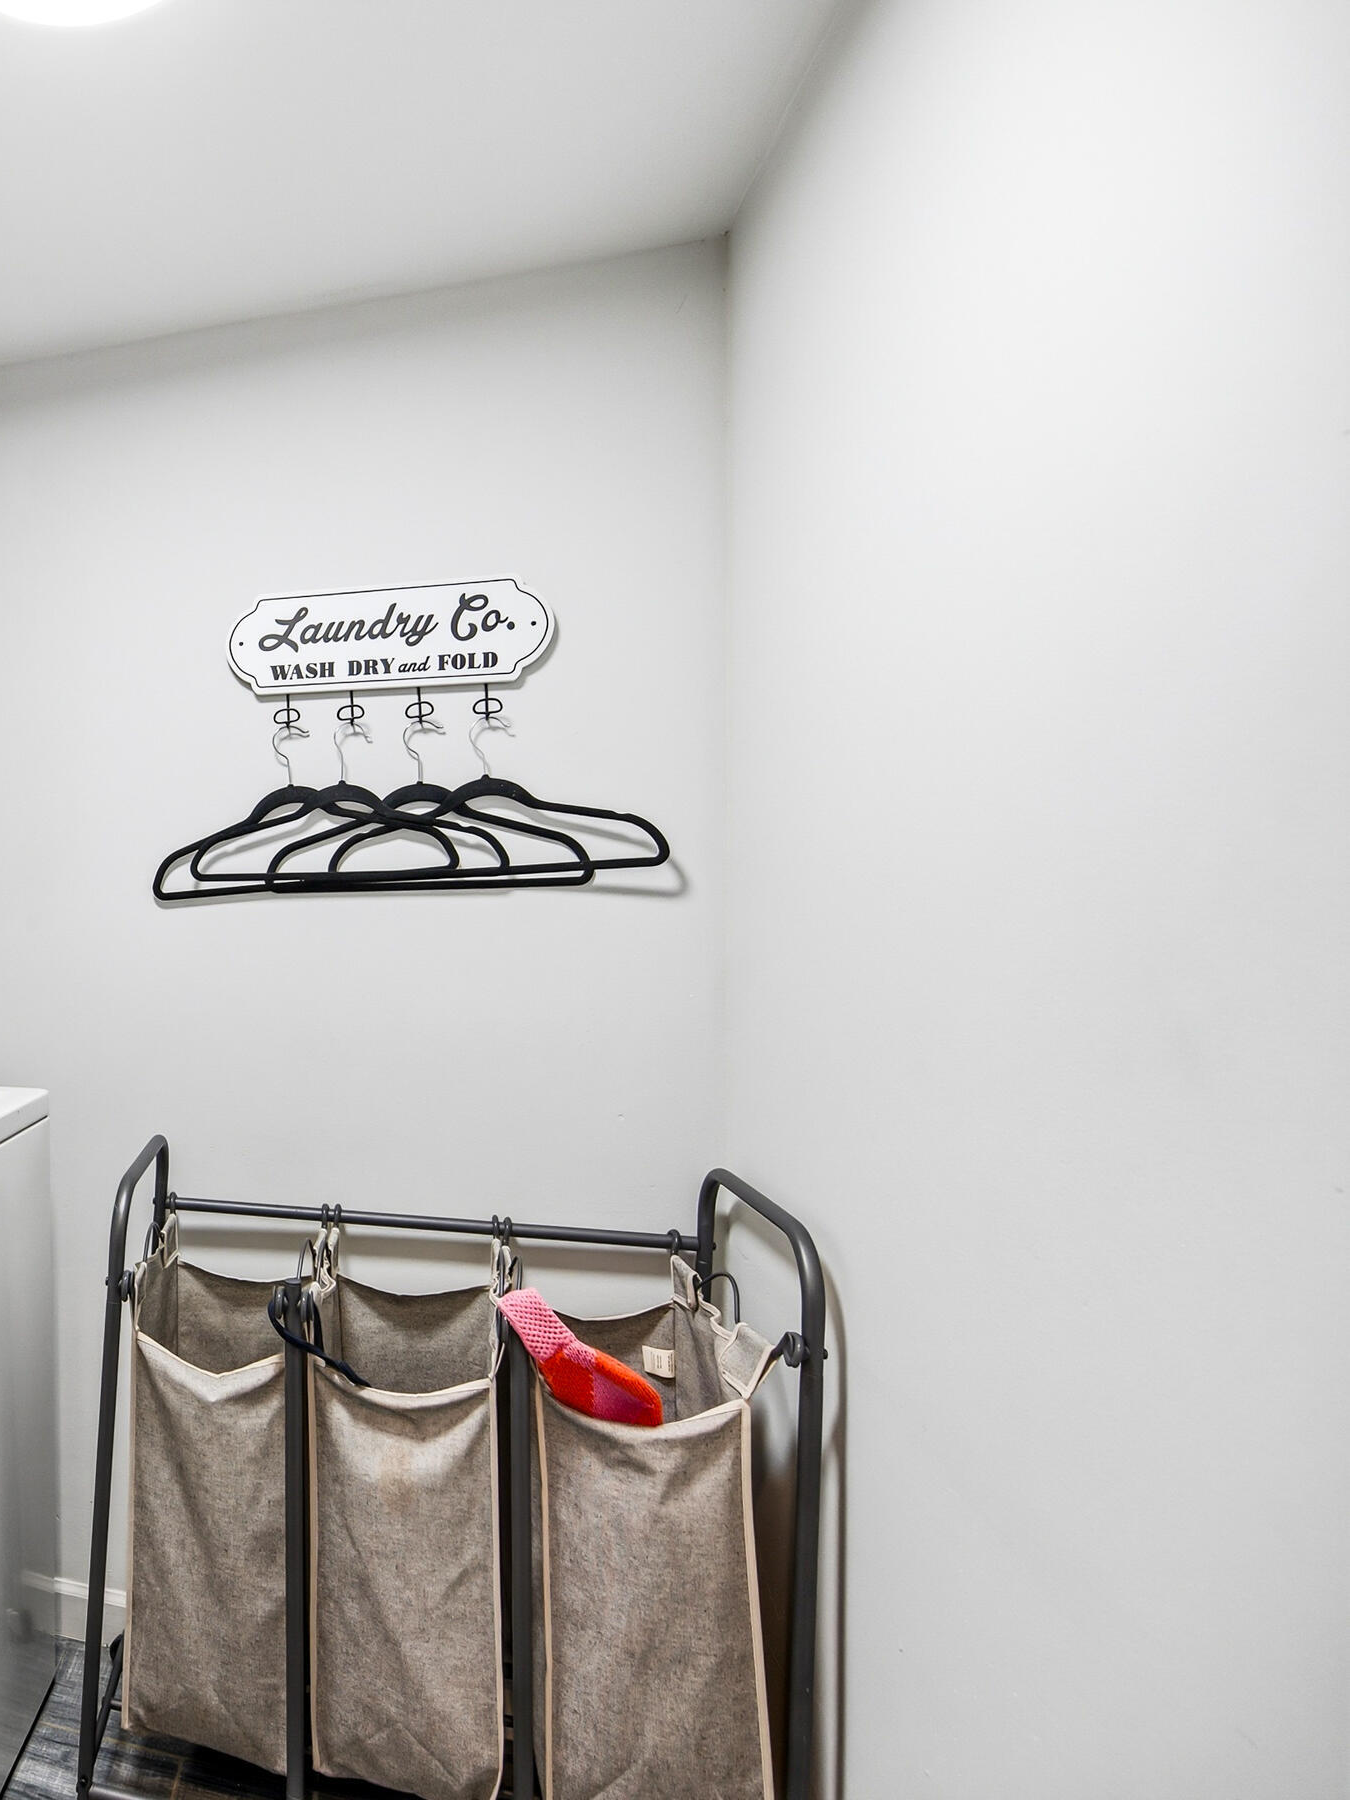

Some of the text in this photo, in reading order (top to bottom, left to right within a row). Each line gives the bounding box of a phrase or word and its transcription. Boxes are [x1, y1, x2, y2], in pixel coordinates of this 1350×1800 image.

[258, 592, 516, 653] Laundry Co.
[270, 650, 499, 681] WASH DRY and FOLD
